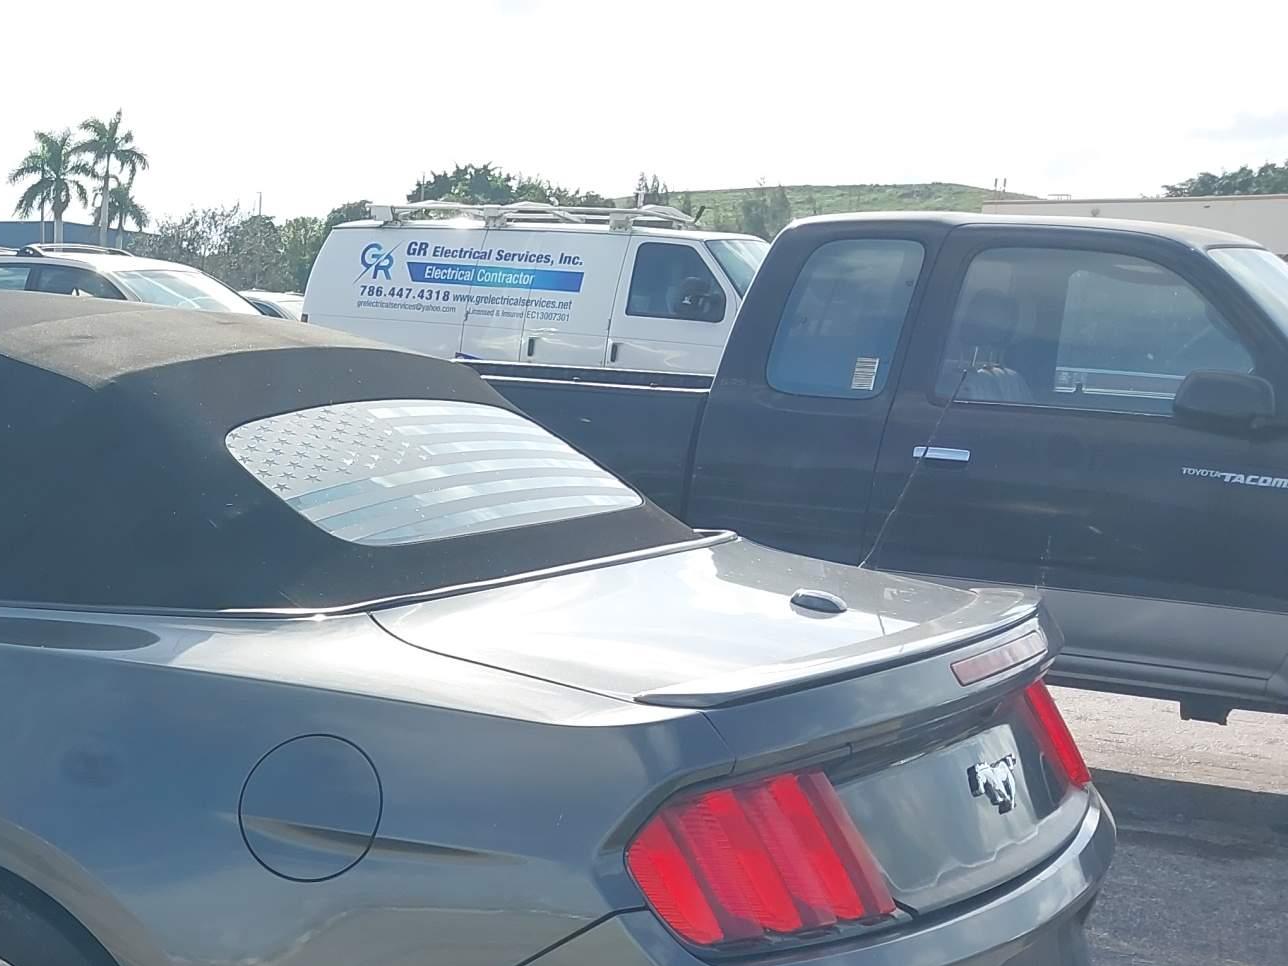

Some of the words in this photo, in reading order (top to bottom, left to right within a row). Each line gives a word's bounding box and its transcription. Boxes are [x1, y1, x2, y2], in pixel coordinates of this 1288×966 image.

[406, 241, 429, 257] GR
[432, 245, 493, 260] Electrical
[495, 249, 554, 266] Services,
[558, 252, 583, 266] Inc.
[424, 265, 475, 281] Electrical
[476, 268, 536, 285] Contractor
[360, 285, 451, 302] 786.447.4318
[1181, 466, 1221, 478] TOYOTA
